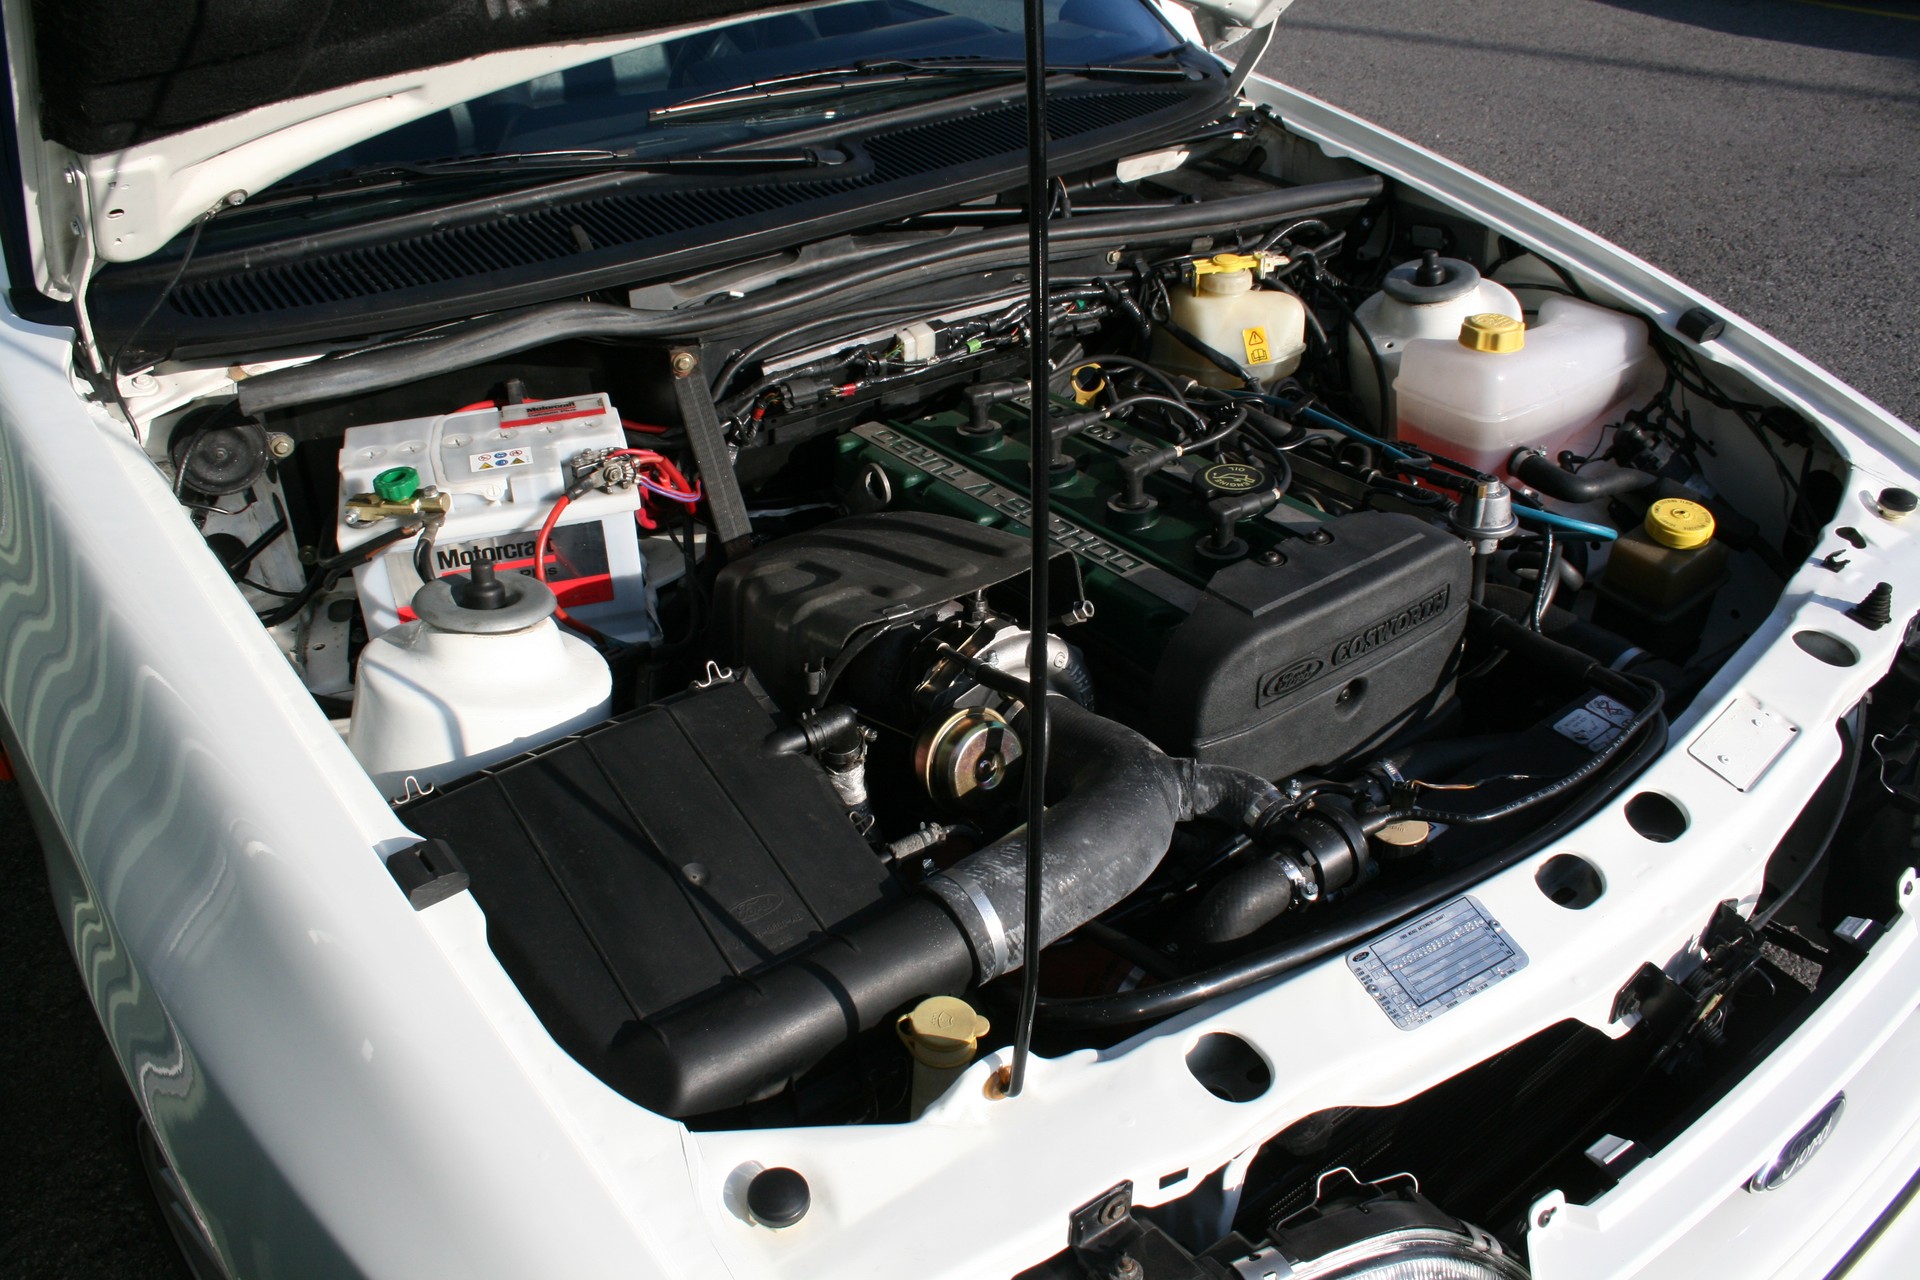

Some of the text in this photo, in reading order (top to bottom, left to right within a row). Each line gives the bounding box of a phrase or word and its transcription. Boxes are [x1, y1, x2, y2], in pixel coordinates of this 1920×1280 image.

[526, 401, 575, 412] Motorcraft
[871, 430, 968, 481] TURBO
[1215, 478, 1251, 488] ENGINE
[436, 538, 554, 570] Motorcrat
[1332, 590, 1448, 666] COSWORTH
[1782, 1115, 1832, 1180] Ford
